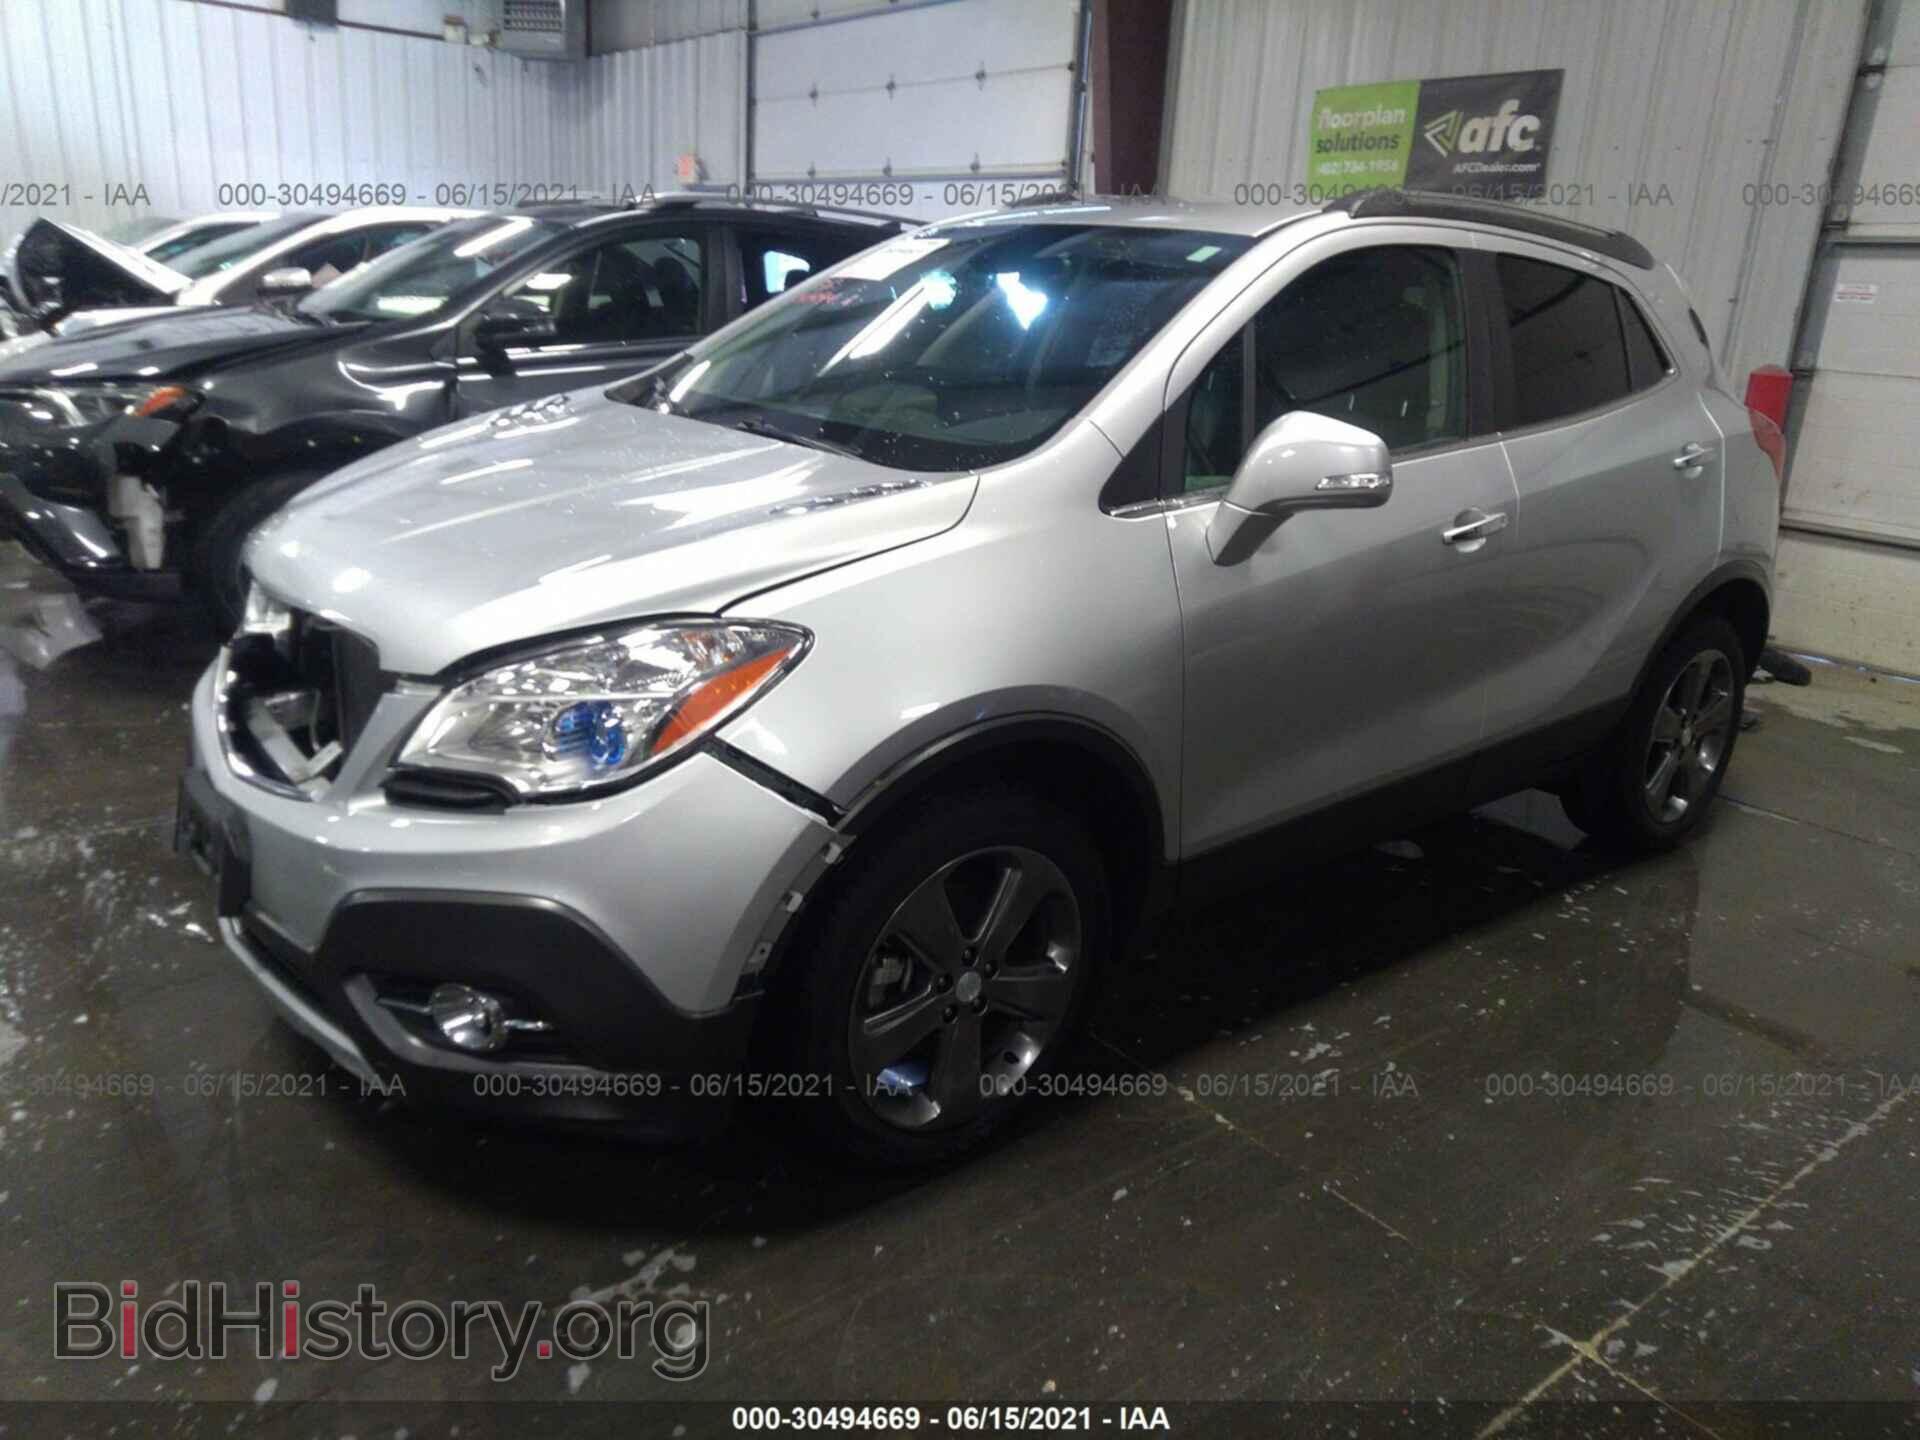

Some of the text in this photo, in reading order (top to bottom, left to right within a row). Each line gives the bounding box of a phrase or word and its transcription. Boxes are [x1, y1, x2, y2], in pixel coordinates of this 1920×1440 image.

[1317, 103, 1406, 130] floorplan
[1458, 98, 1541, 153] afc
[1315, 131, 1401, 154] solutions
